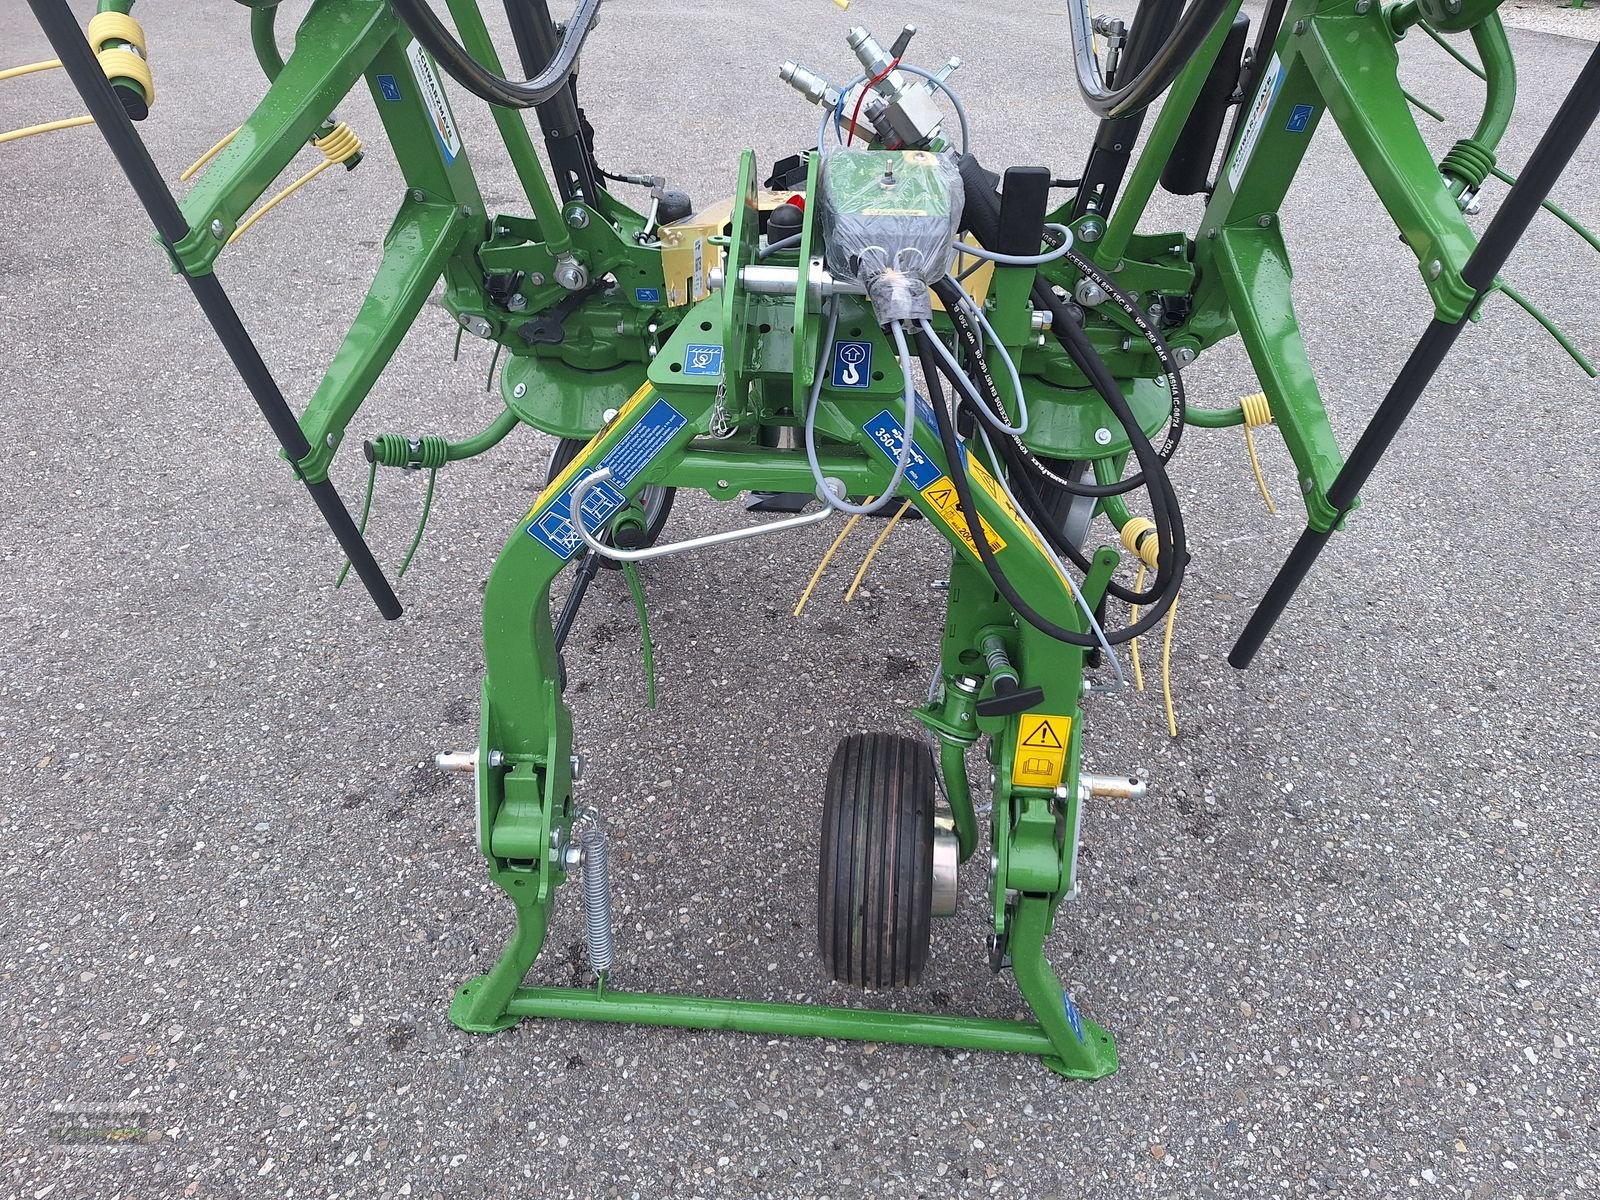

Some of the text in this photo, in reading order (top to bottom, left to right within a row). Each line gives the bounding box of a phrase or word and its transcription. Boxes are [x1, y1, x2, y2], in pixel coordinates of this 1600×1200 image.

[417, 46, 453, 138] SCHWARZMAYR
[1232, 75, 1272, 170] SCHWARZMAYR
[1041, 232, 1057, 247] 108S
[1065, 251, 1092, 275] XCEEDS
[1090, 272, 1103, 284] EN
[1100, 281, 1113, 293] 857
[958, 314, 968, 329] 250
[1135, 316, 1147, 329] WP
[966, 331, 975, 345] WP
[1144, 330, 1157, 344] 250
[1154, 345, 1168, 362] BAR
[989, 386, 998, 397] EN
[1167, 372, 1179, 396] MSHA
[994, 396, 1012, 427] EXCEEDS
[1160, 439, 1174, 458] 2024
[959, 527, 973, 542] 200
